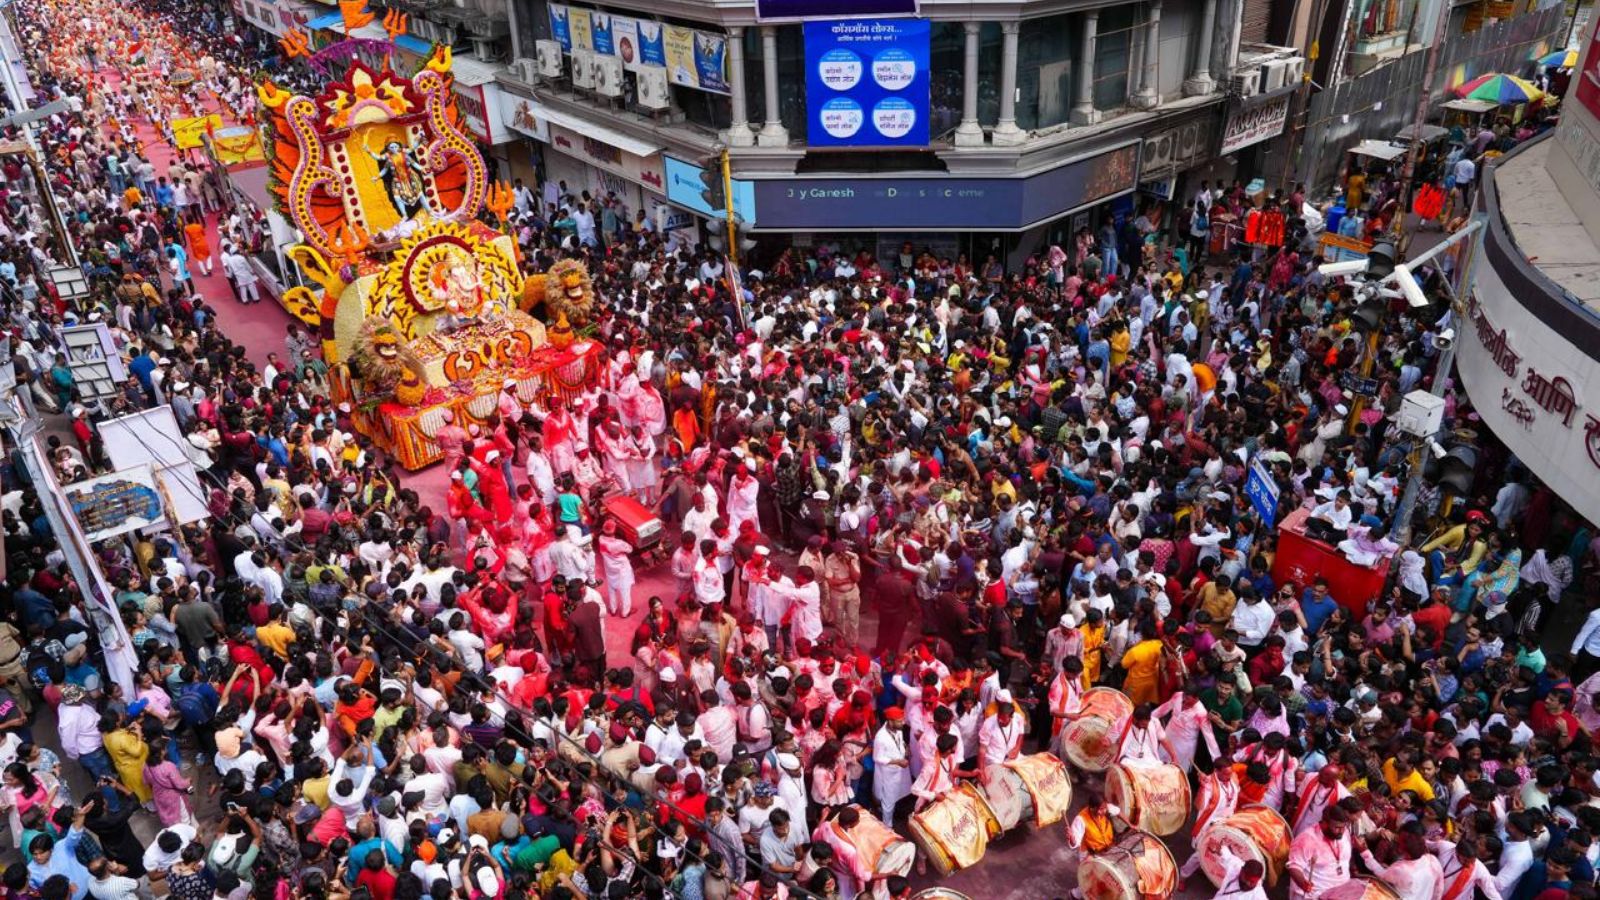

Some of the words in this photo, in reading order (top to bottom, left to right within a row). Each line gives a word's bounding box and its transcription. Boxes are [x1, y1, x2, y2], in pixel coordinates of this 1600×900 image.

[1225, 102, 1285, 138] ANURADHA
[810, 187, 854, 198] Ganesh
[667, 213, 690, 226] ATM
[1521, 368, 1579, 426] आणि
